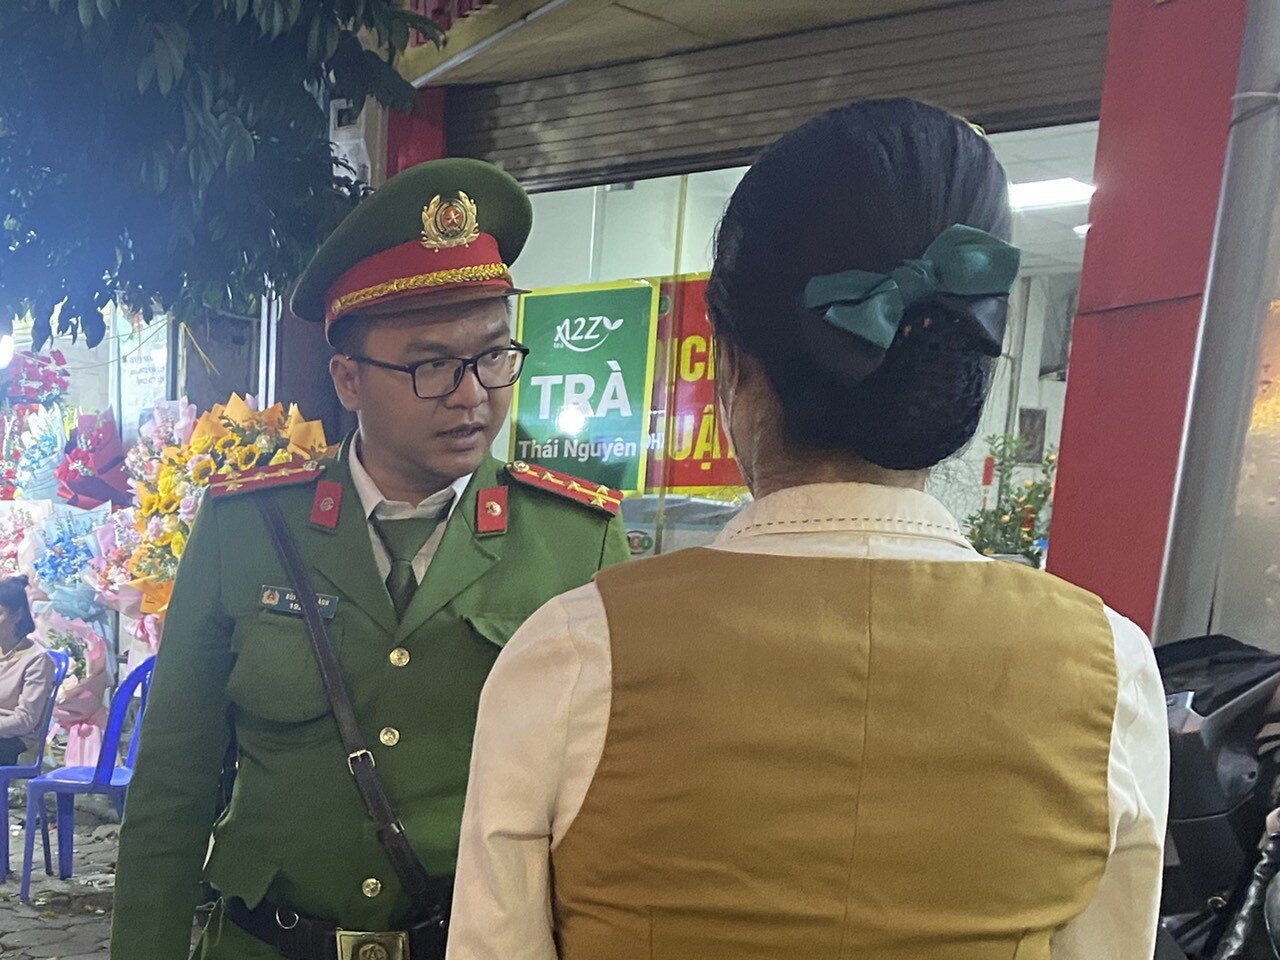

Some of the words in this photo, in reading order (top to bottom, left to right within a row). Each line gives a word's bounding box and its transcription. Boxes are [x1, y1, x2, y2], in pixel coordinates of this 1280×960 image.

[531, 360, 633, 420] TRÀ
[518, 438, 558, 459] Thái
[563, 437, 637, 463] Nguyên
